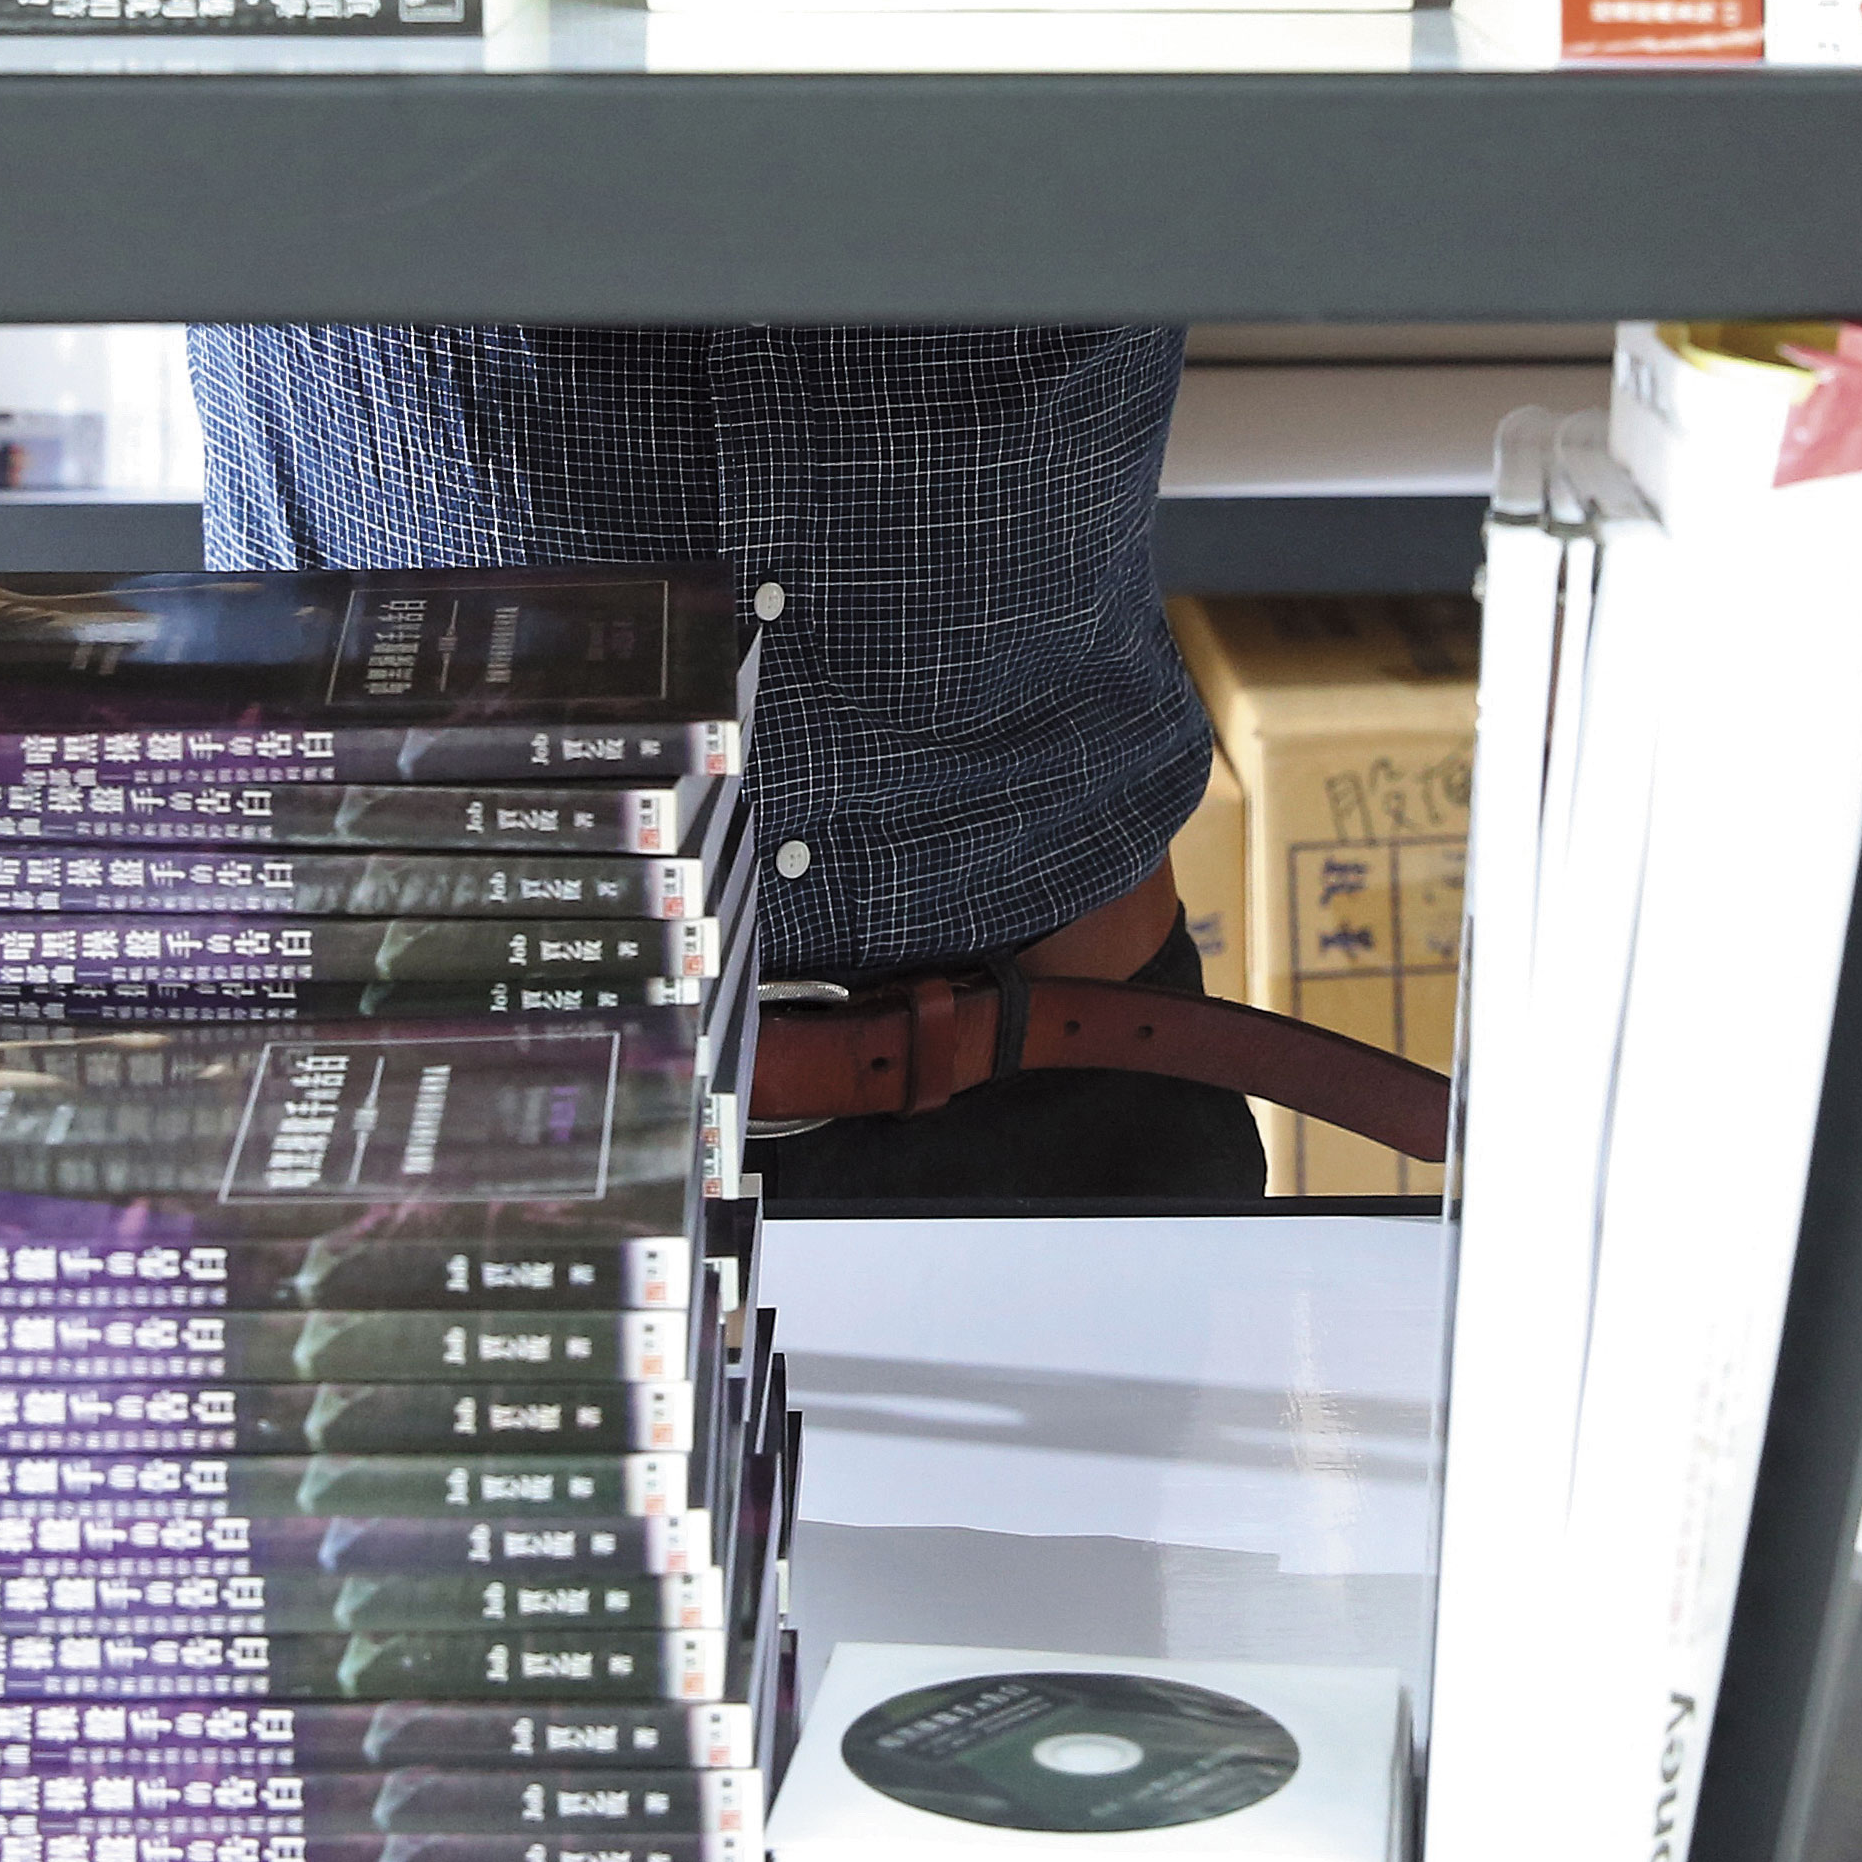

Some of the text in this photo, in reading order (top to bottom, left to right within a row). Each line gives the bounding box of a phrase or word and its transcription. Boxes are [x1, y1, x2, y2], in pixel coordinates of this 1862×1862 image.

[531, 733, 549, 765] Job
[466, 802, 484, 833] Job
[487, 872, 507, 902] Job
[509, 935, 526, 965] Job
[490, 984, 507, 1011] Job
